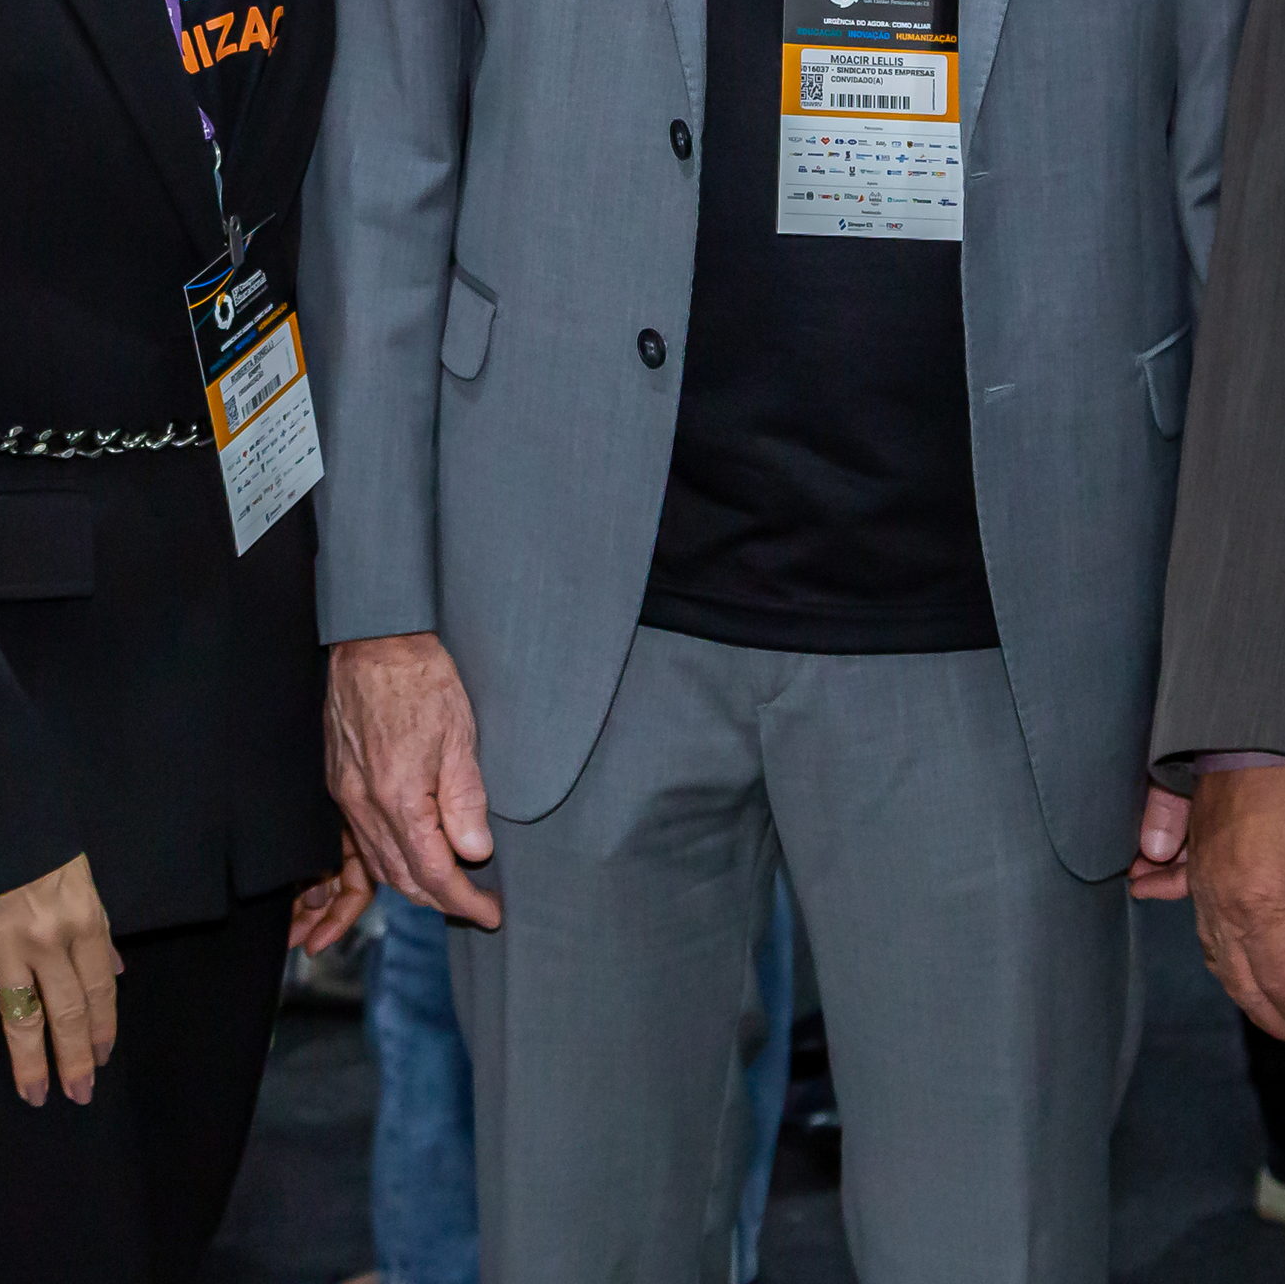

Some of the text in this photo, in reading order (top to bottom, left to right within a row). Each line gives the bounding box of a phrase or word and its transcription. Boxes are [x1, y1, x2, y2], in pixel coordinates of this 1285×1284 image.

[823, 18, 855, 26] URGÊNCIA
[896, 32, 957, 44] HUMANIZAÇÃO
[830, 55, 904, 67] MOACIR LELLIS
[837, 67, 876, 75] SINDICATO
[878, 68, 893, 76] DAS
[895, 69, 935, 77] EMPRESAS
[830, 75, 884, 85] CONVIDADO(A)
